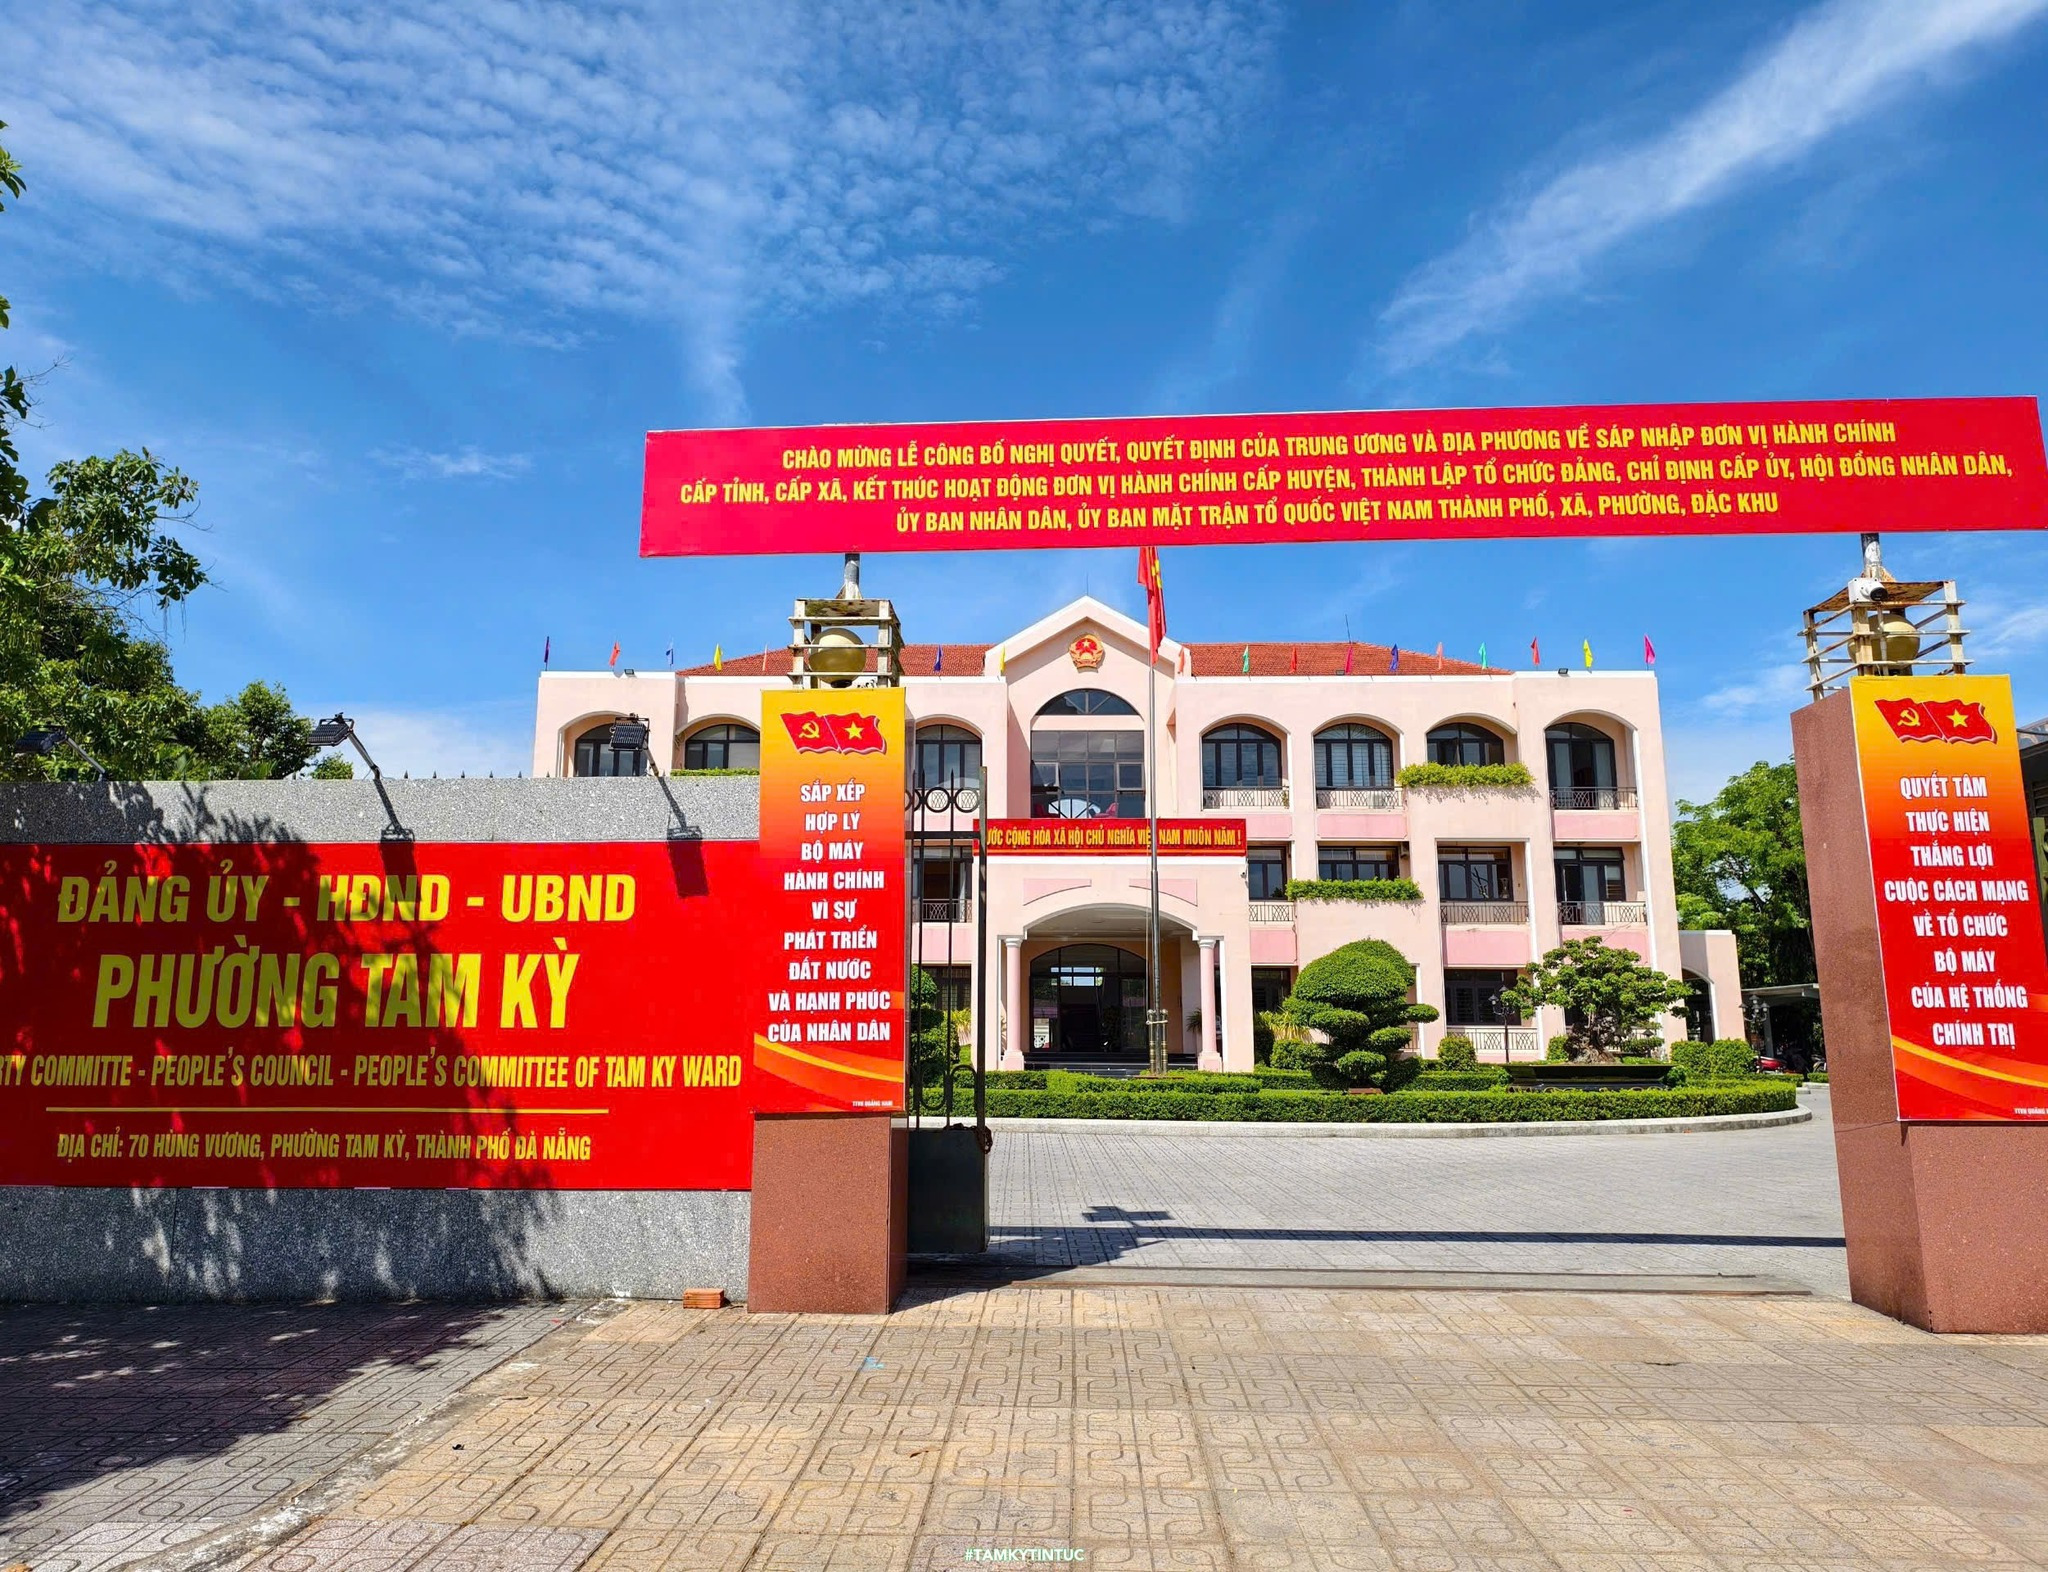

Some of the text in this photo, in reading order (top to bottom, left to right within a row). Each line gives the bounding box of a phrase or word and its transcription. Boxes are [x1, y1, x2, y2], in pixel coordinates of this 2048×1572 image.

[783, 420, 1895, 469] CHÀO MỪNG LỄ CÔNG BỐ NGHỊ QUYẾT, QUYẾT ĐỊNH CỦA TRUNG ƯƠNG VÀ ĐỊA PHƯƠNG VỀ SÁP NHẬP ĐƠN VỊ HÀNH CHÍNH
[681, 451, 2012, 503] CẤP TỈNH, CẤP XÃ, KẾT THÚC HOẠT ĐỘNG ĐƠN VỊ HÀNH CHÍNH CẤP HUYỆN, THÀNH LẬP TỔ CHỨC ĐẢNG, CHỈ ĐỊNH CẤP ỦY, HỘI ĐỒNG NHÂN DÂN,
[897, 490, 1778, 532] ỦY BAN NHÂN DÂN, ỦY BAN MẶT TRẬN TỔ QUỐC VIỆT NAM THÀNH PHỐ, XÃ, PHƯỜNG, ĐẶC KHU
[801, 780, 865, 803] SẮP XẾP
[1900, 770, 1987, 799] QUYẾT TÂM
[805, 810, 860, 834] HỢP LÝ
[1906, 808, 1990, 835] THỰC HIỆN
[1006, 827, 1030, 848] CỘNG
[1033, 827, 1050, 845] HÒA
[1054, 827, 1065, 844] XÃ
[1068, 827, 1083, 848] HỘI
[1086, 825, 1104, 844] CHỦ
[1108, 827, 1135, 844] NGHĨA
[1137, 825, 1151, 848] VIỆ
[1159, 830, 1180, 844] NAM
[1184, 827, 1211, 845] MUÔN
[1214, 827, 1235, 845] NĂM
[801, 840, 863, 863] BỘ MÁY
[1910, 840, 1993, 869] THẮNG LỢI
[58, 861, 190, 922] ĐẢNG
[207, 860, 269, 922] ỦY
[317, 875, 450, 921] HĐND
[502, 874, 635, 922] UBND
[784, 869, 884, 890] HÀNH CHÍNH
[1884, 878, 2029, 905] CUỘC CÁCH MẠNG
[812, 899, 857, 922] VÌ SỰ
[1913, 909, 2008, 936] VỀ TỔ CHỨC
[784, 925, 877, 950] PHÁT TRIỂN
[789, 957, 871, 980] ĐẤT NƯỚC
[1934, 948, 1995, 976] BỘ MÁY
[93, 935, 580, 1028] PHƯỜNG TAM KỲ
[768, 989, 890, 1013] VÀ HẠNH PHÚC
[1911, 981, 2028, 1011] CỦA HỆ THỐNG
[768, 1019, 890, 1042] CỦA NHÂN DÂN
[1933, 1020, 2015, 1049] CHÍNH TRỊ
[0, 1055, 26, 1085] TY
[31, 1056, 132, 1086] COMMITTE
[251, 1055, 333, 1085] COUNCIL
[454, 1056, 569, 1087] COMMITTEE
[575, 1056, 600, 1087] OF
[605, 1056, 646, 1087] TAM
[652, 1056, 677, 1087] KY
[683, 1056, 741, 1087] WARD
[58, 1127, 591, 1162] ĐỊA CHỈ: 70 HÙNG VƯƠNG, PHƯỜNG TAM KỲ, THÀNH PHỐ ĐÀ NẴNG
